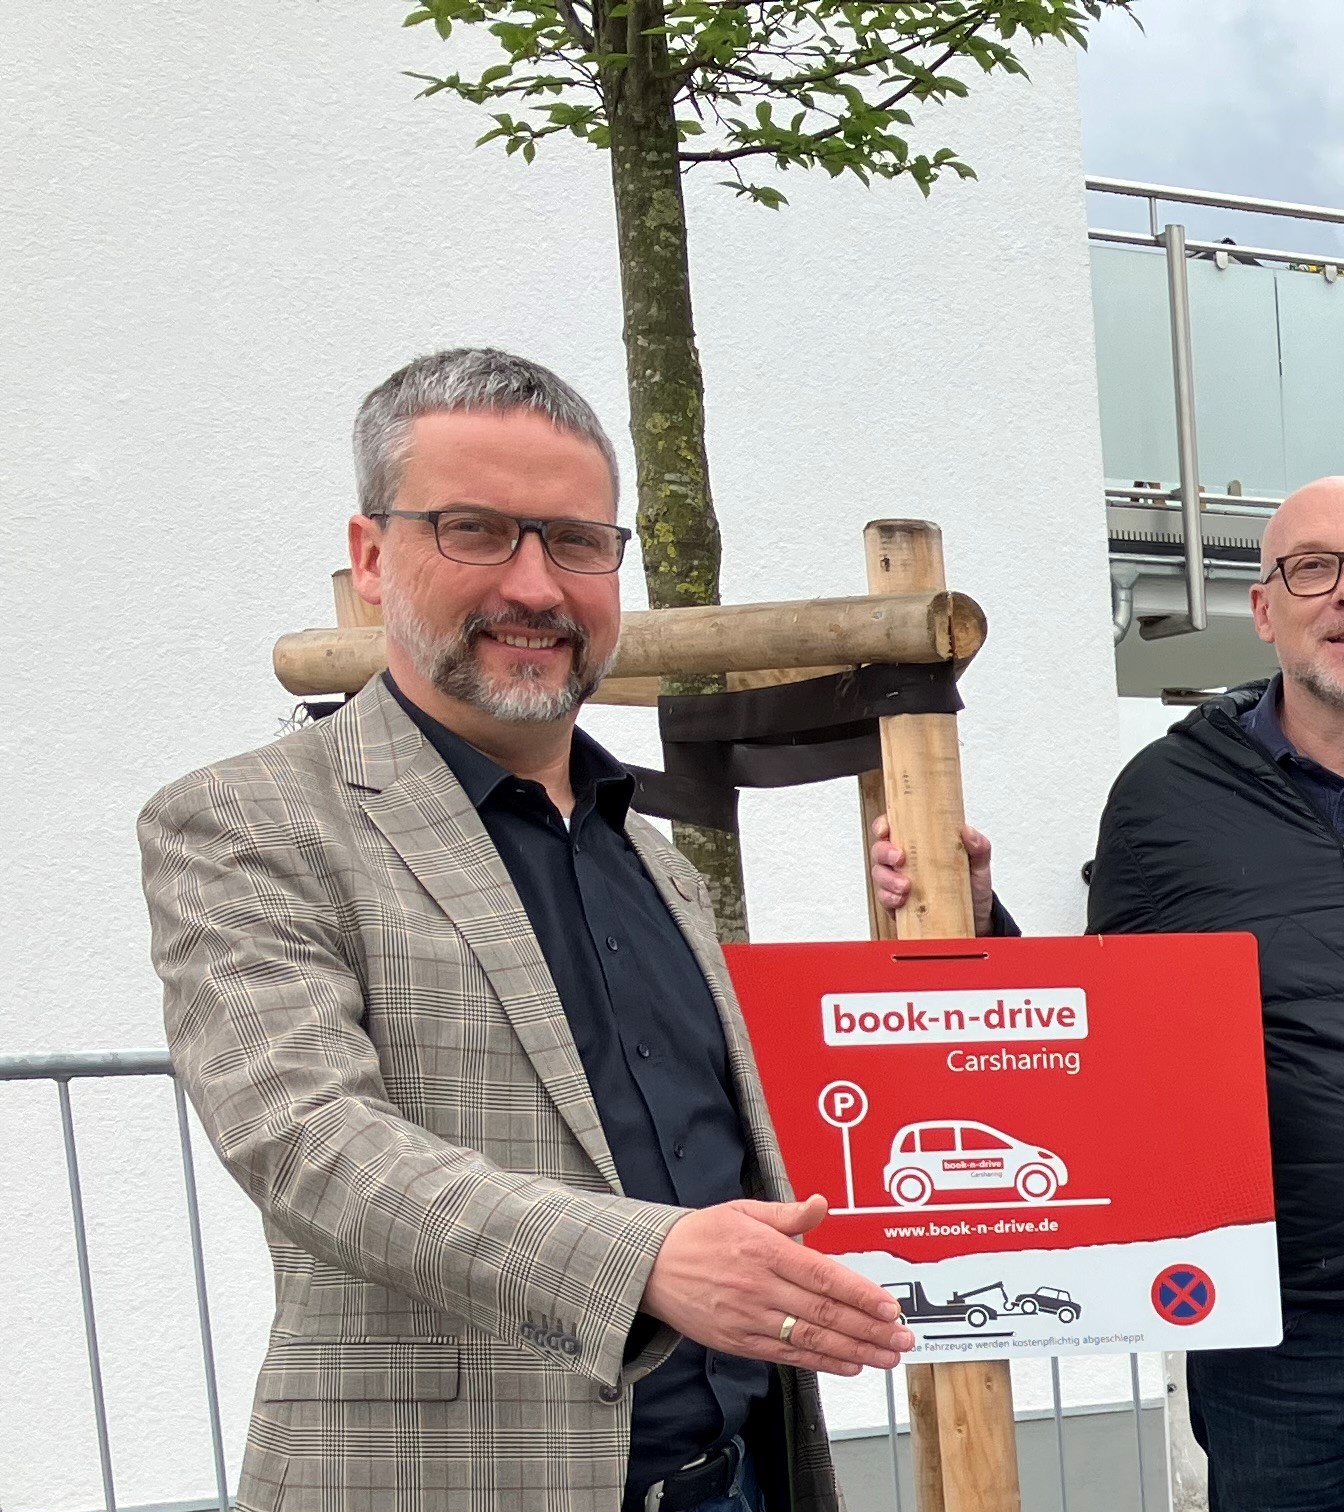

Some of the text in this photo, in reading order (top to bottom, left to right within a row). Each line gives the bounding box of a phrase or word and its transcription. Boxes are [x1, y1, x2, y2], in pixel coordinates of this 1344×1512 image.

[833, 998, 1077, 1034] book-n-drive
[946, 1048, 1081, 1075] Carsharing
[833, 1092, 855, 1117] P
[884, 1218, 1059, 1239] www.book-n-drive.de
[924, 1342, 973, 1352] Fahrzeuge
[975, 1340, 1009, 1349] werden
[1012, 1335, 1080, 1347] kostenpflichtig
[1082, 1333, 1145, 1346] abgeschleppt
